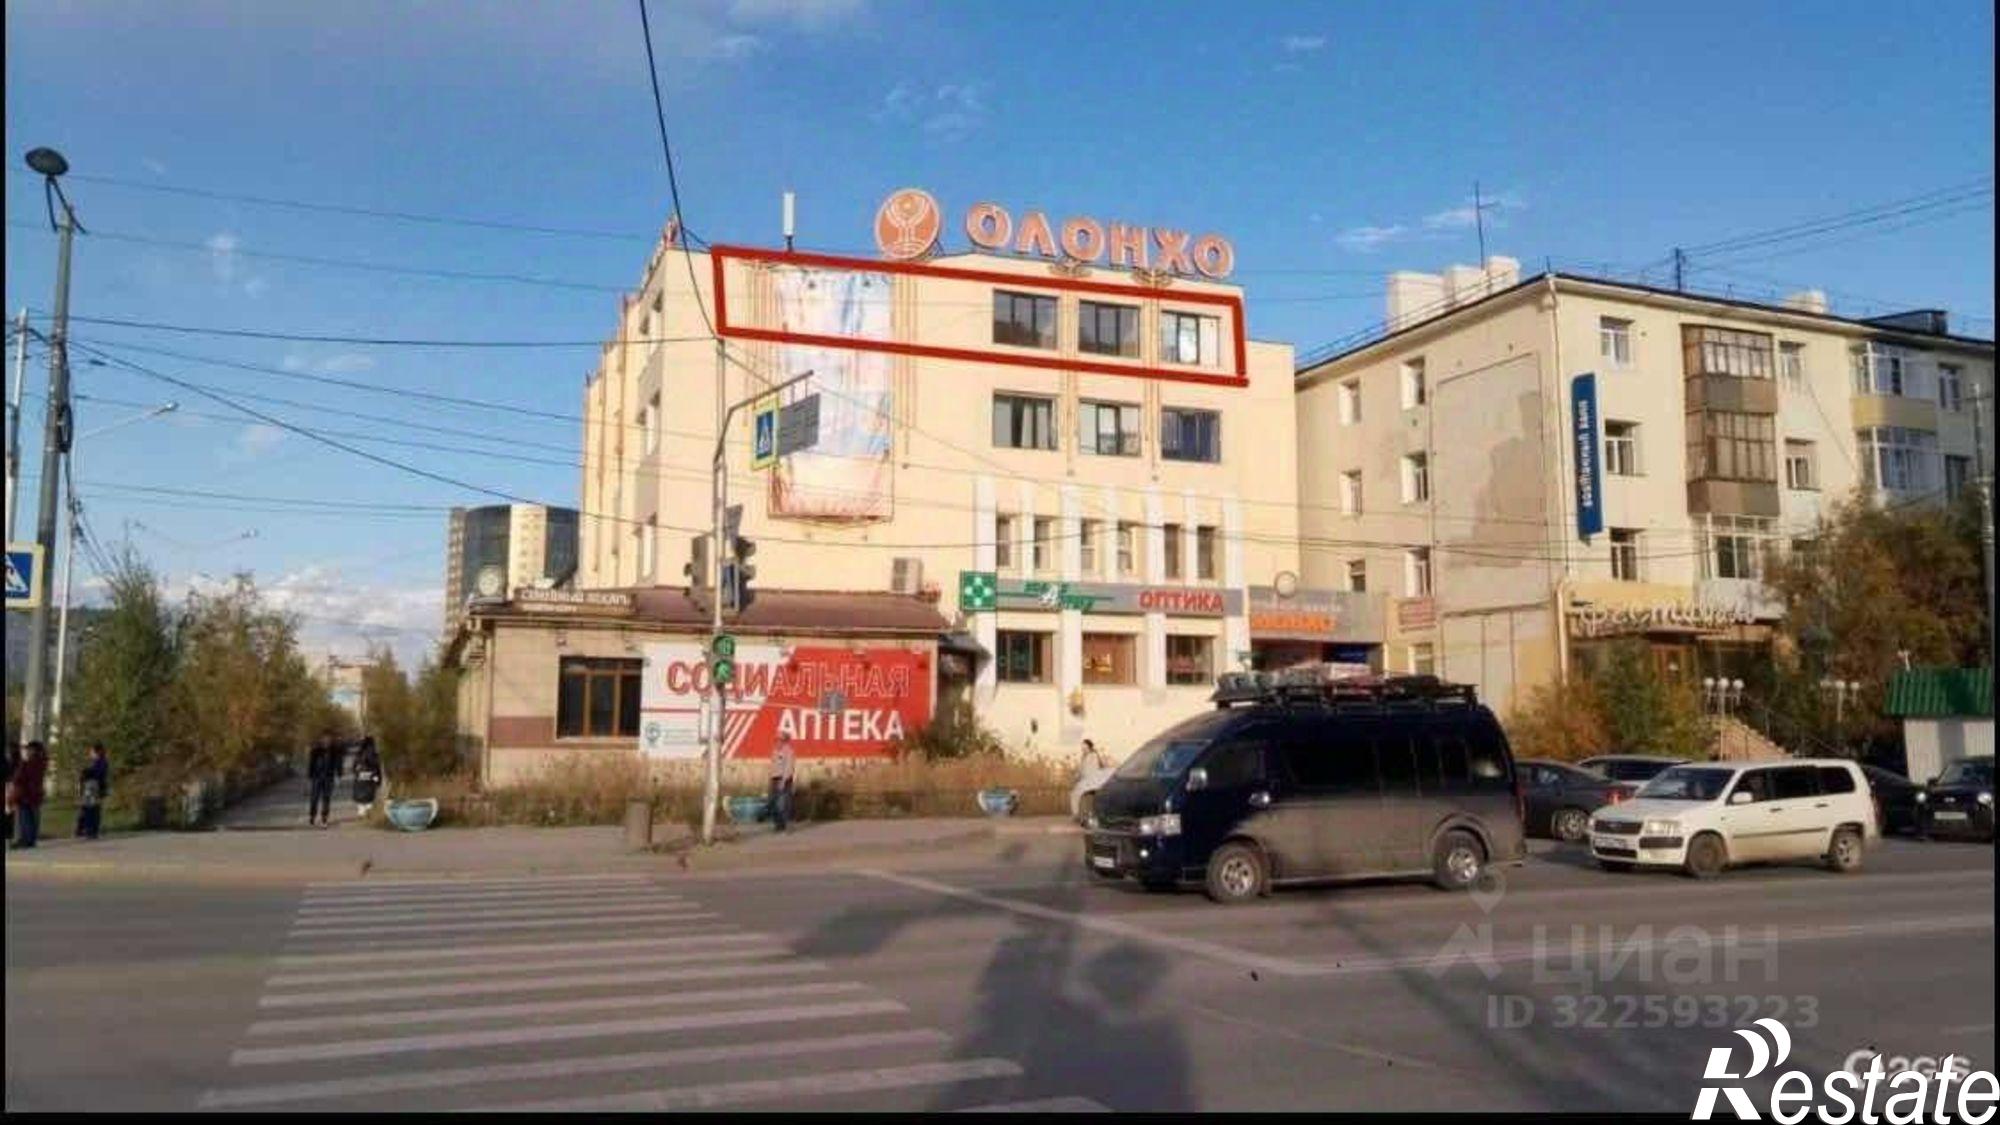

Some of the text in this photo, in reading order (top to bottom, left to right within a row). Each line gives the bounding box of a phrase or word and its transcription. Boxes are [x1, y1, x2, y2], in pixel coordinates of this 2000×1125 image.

[966, 202, 1235, 280] ОЛОНХО
[1139, 588, 1224, 613] ОПТИКА
[777, 708, 905, 741] АПТЕКА
